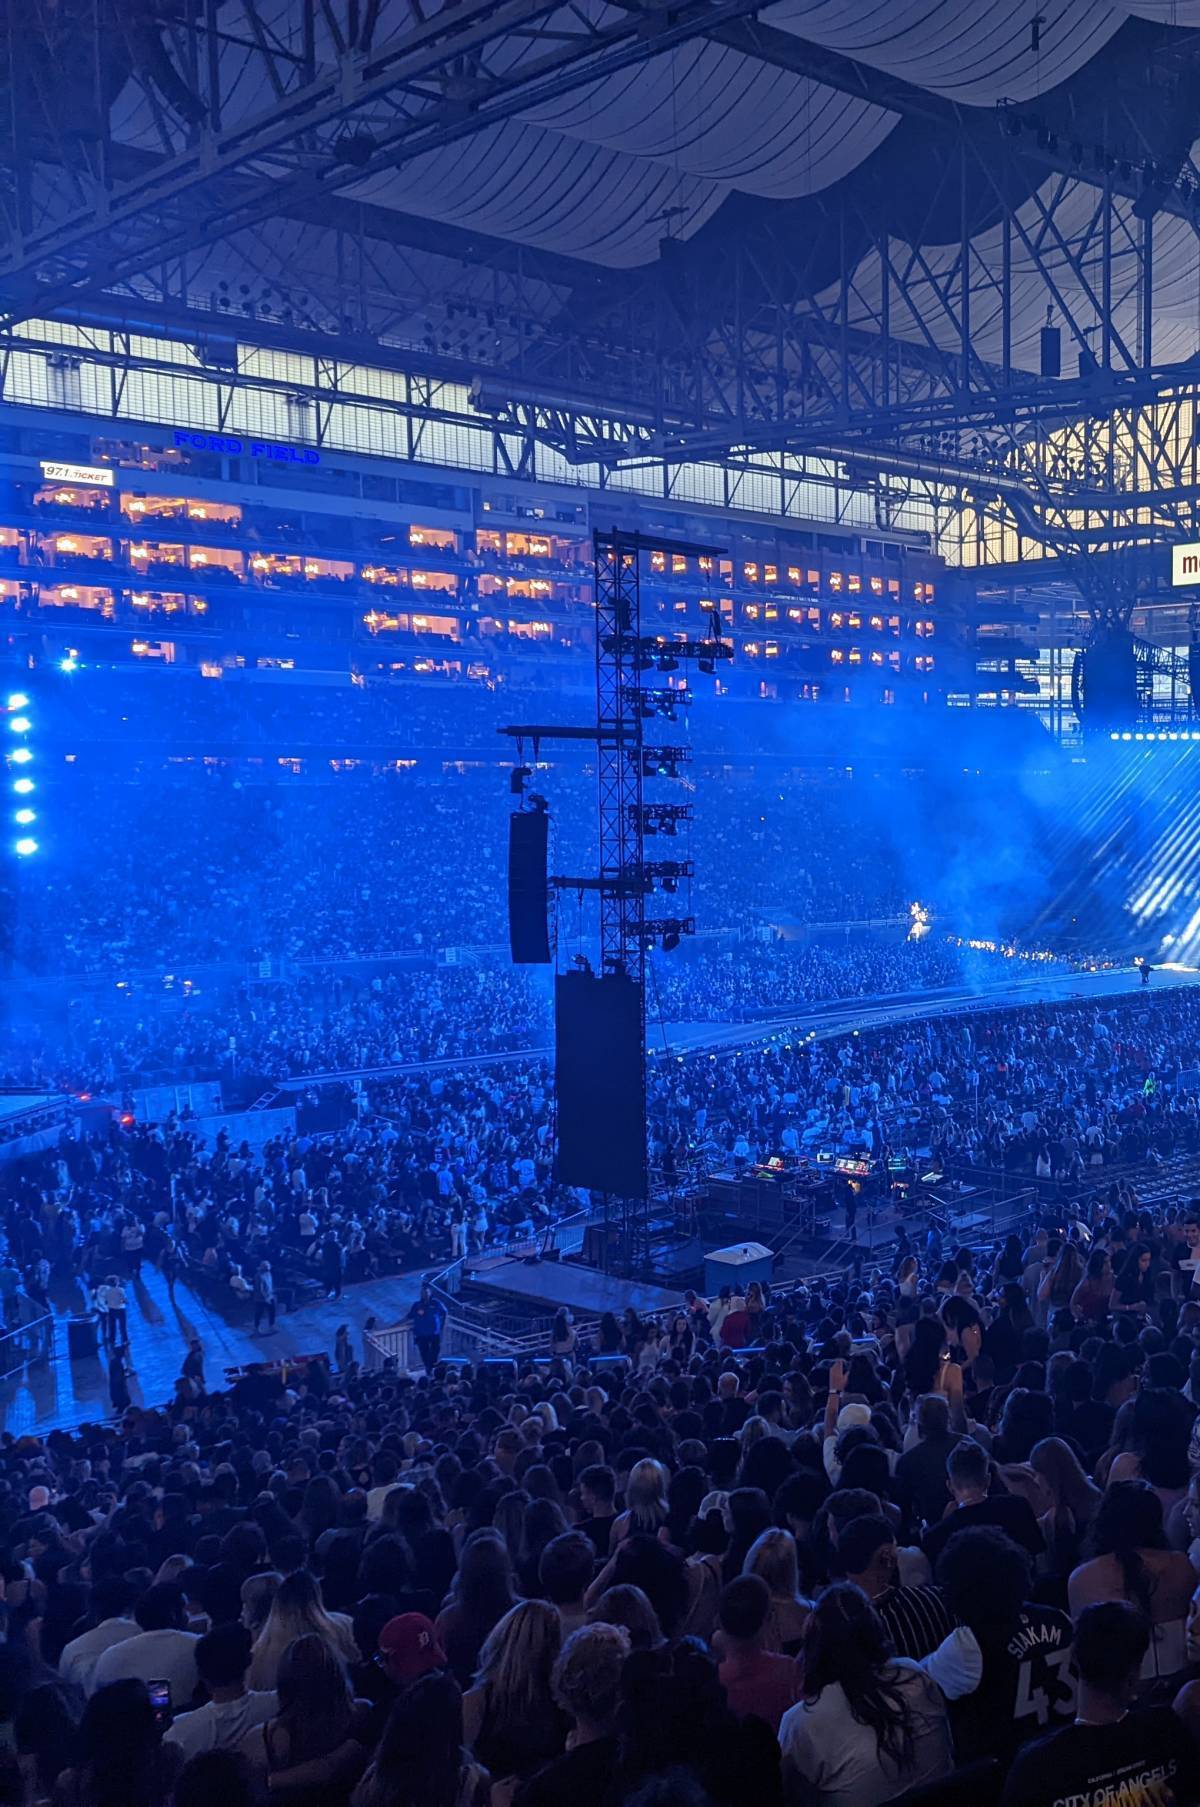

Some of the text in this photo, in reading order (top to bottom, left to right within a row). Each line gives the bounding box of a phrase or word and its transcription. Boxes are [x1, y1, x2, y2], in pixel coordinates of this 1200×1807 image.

[173, 431, 321, 465] FORD FIELD
[46, 466, 69, 478] 97.1
[73, 470, 108, 481] TICKET
[1007, 1623, 1062, 1660] SIAKAM
[1013, 1645, 1079, 1725] 43
[1118, 1757, 1178, 1796] ANGELS
